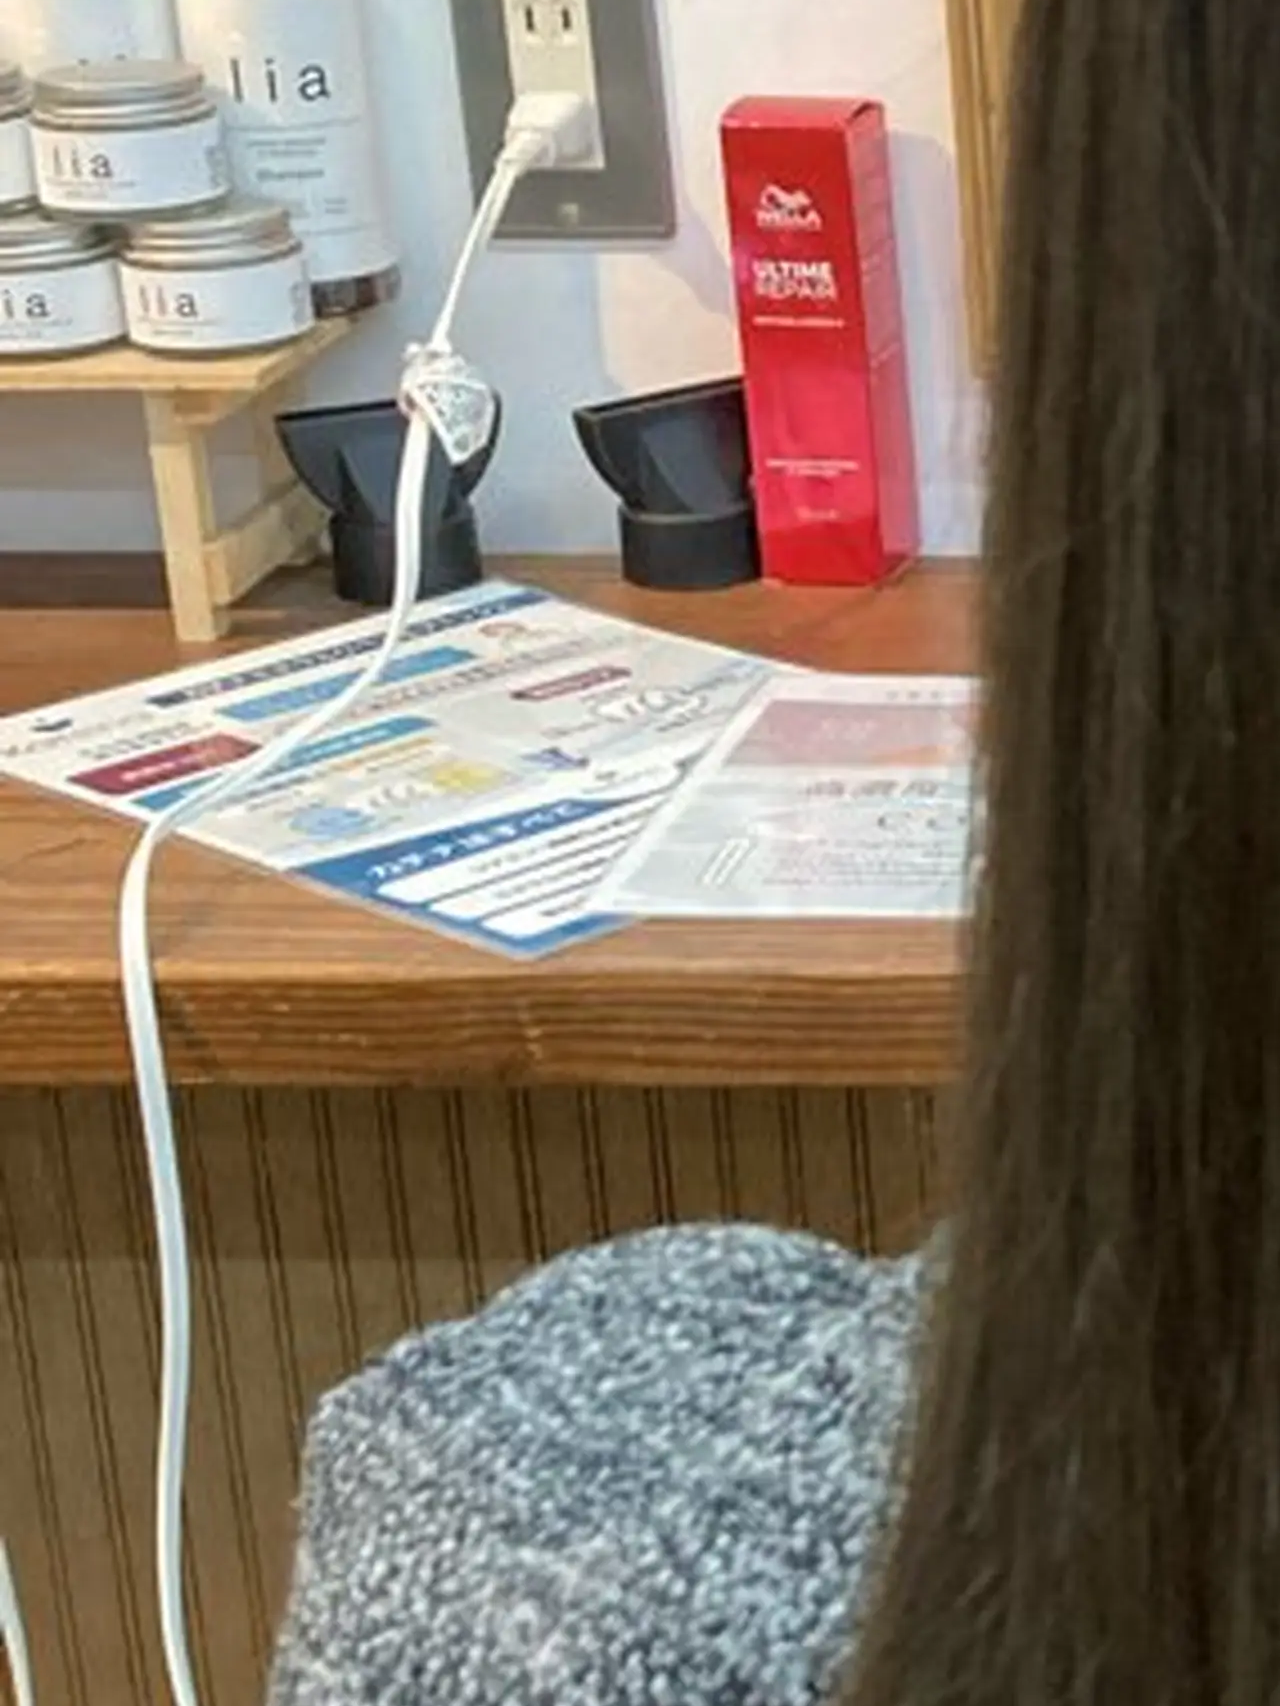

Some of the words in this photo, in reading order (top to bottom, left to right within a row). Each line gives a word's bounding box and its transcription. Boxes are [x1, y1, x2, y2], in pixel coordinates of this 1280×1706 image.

[229, 58, 331, 103] lia
[53, 145, 112, 179] lia
[139, 284, 198, 318] lia
